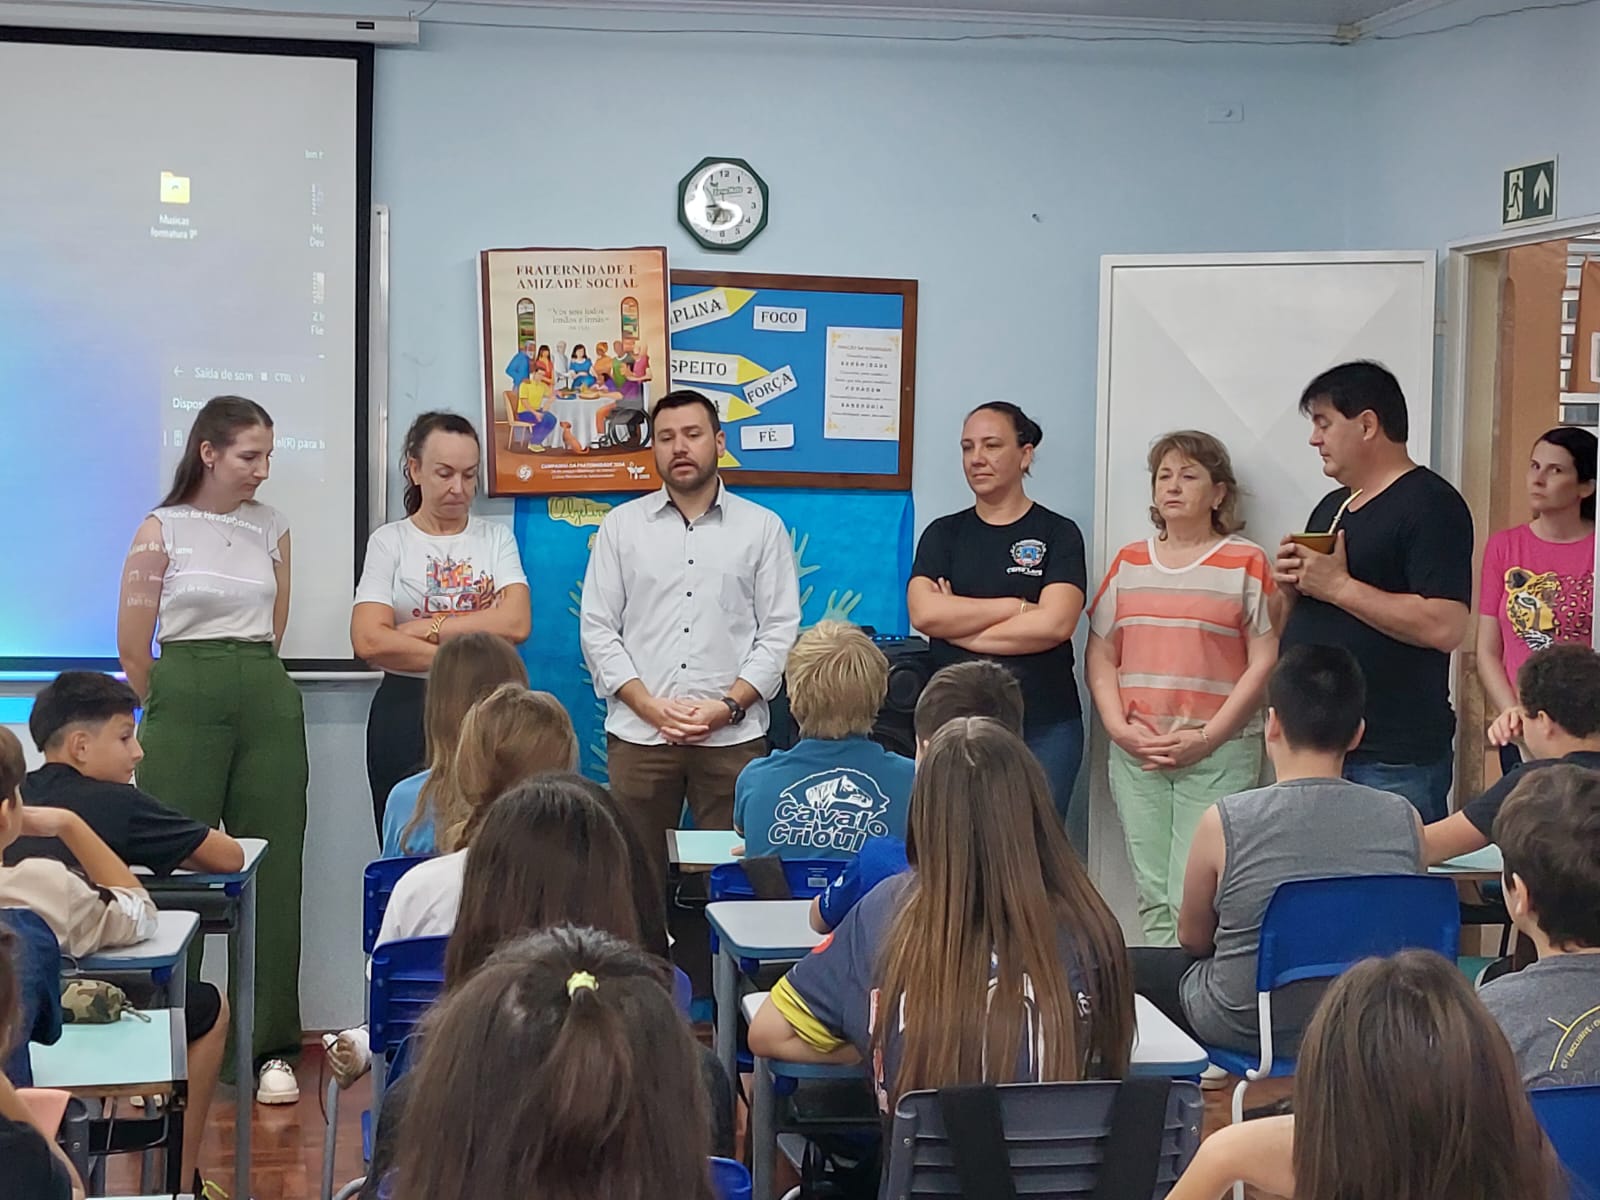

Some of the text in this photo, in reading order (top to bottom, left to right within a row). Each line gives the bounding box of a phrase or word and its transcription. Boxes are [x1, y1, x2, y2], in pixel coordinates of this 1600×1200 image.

[516, 264, 638, 276] FRATERNIDADE E
[517, 277, 639, 290] AMIZADE SOCIAL
[761, 311, 798, 324] FOCO
[234, 371, 254, 382] som
[747, 372, 794, 403] FORÇA
[172, 397, 204, 411] Dispos
[759, 427, 777, 443] FÉ
[775, 800, 889, 837] Cavalo
[768, 821, 867, 853] Crioul
